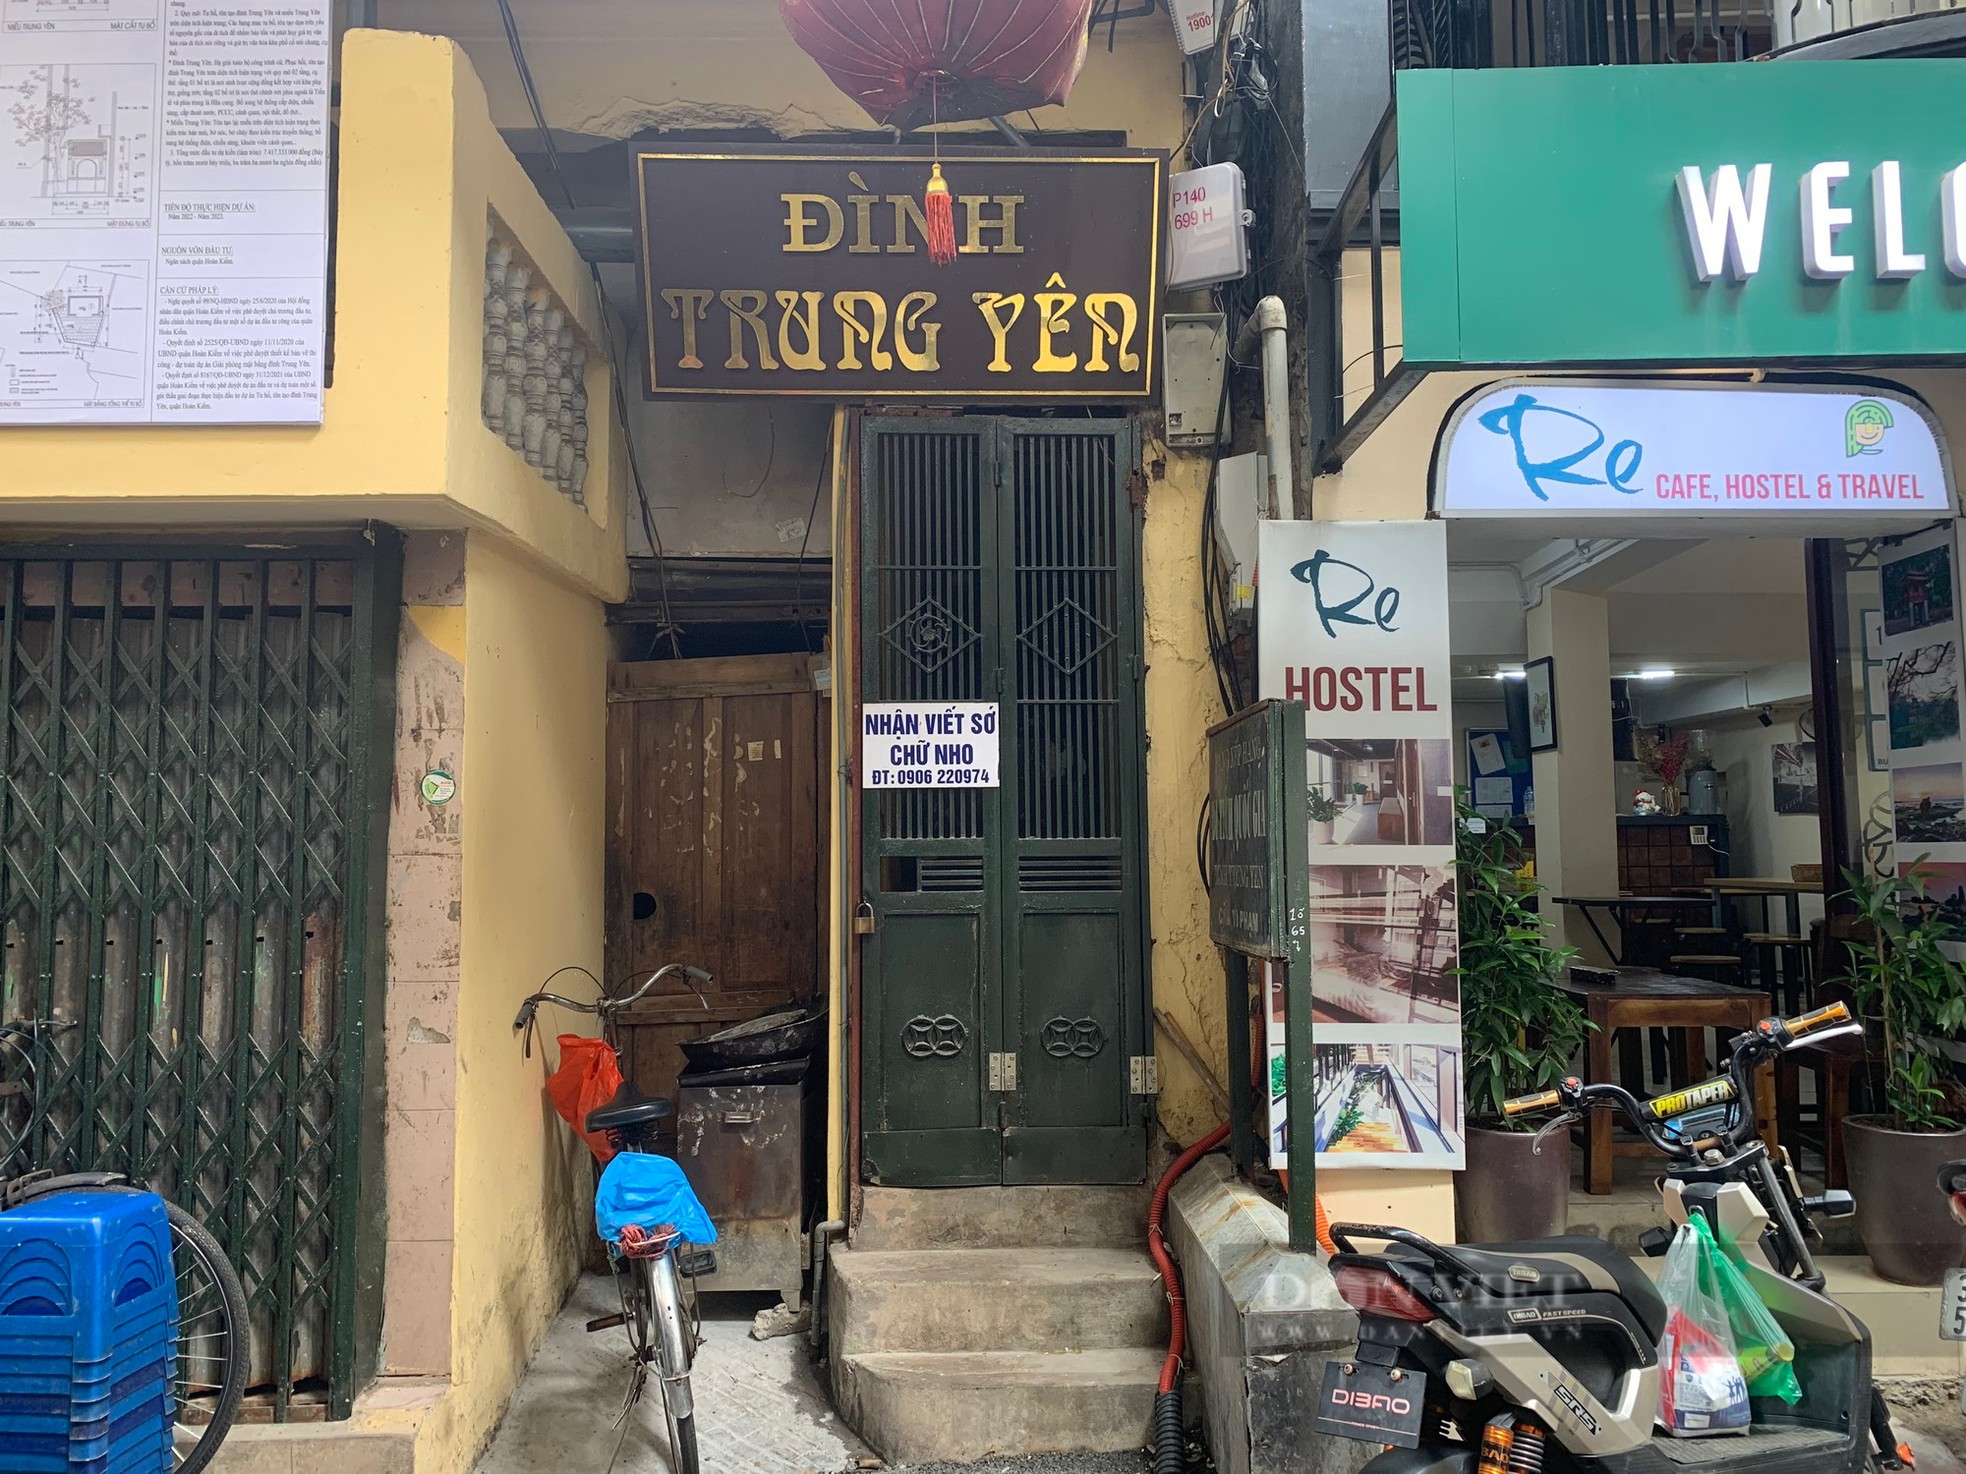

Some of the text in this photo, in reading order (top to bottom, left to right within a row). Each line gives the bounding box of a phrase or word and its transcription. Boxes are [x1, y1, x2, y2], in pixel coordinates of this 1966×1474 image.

[780, 171, 1024, 253] ĐÌNH
[1173, 187, 1206, 208] P140
[1174, 206, 1213, 230] 699 H
[661, 272, 1139, 372] TRUNG YÊN
[1479, 394, 1643, 501] Re
[1656, 474, 1925, 502] CAFE, HOSTEL & TRAVEL
[1290, 549, 1400, 638] Re
[1285, 666, 1437, 711] HOSTEL
[866, 706, 995, 739] NHẬN VIẾT SỚ
[891, 740, 973, 765] CHỮ NHO
[937, 769, 989, 784] 220974
[1291, 925, 1305, 936] 65
[1332, 1388, 1410, 1415] DIBAO
[1556, 1387, 1595, 1430] SRS
